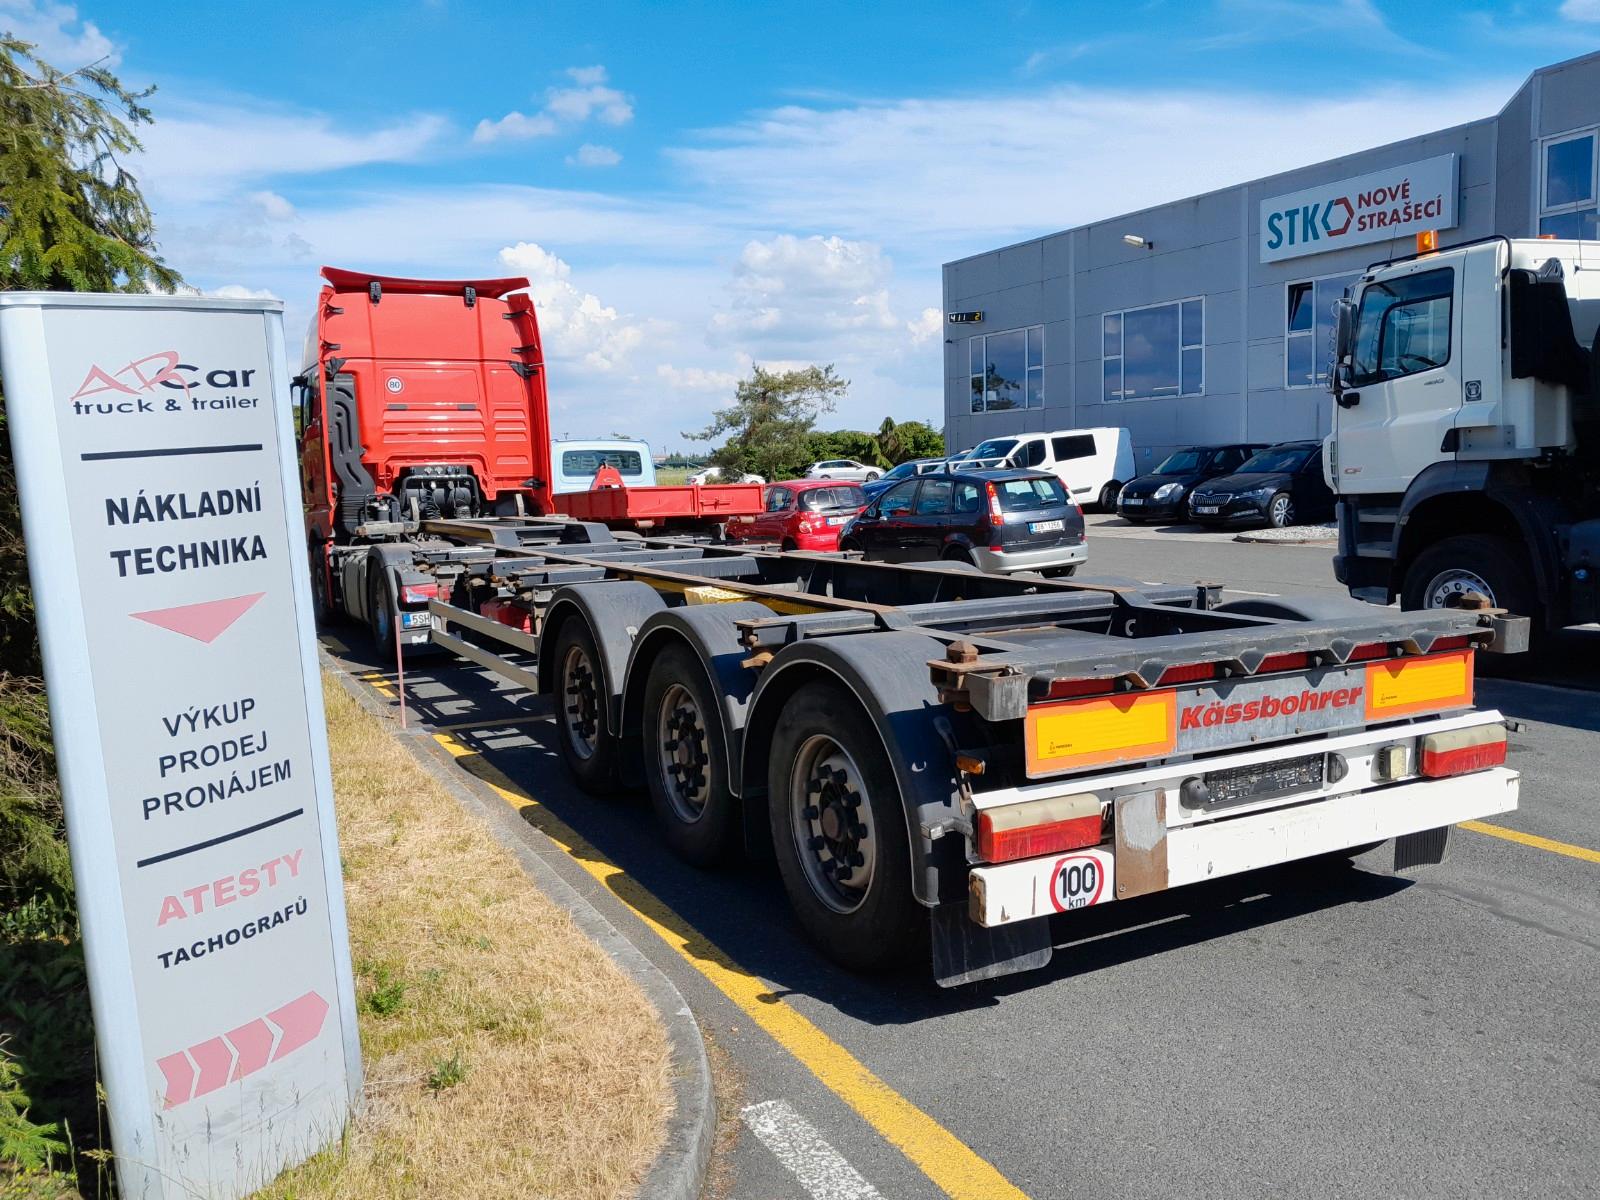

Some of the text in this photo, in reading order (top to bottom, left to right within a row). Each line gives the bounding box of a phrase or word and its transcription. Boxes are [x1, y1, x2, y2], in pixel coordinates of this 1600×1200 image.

[1357, 194, 1442, 232] STRAŠECÍ
[1358, 178, 1410, 209] NOVÉ
[1267, 203, 1320, 249] STK
[73, 396, 259, 415] truck & trailer
[105, 481, 262, 526] NÁKLADNÍ
[110, 535, 267, 577] TECHNIKA
[162, 698, 255, 737] VÝKUP
[1180, 686, 1363, 731] Kässbohrer
[159, 731, 267, 778] PRODEJ
[142, 759, 292, 820] PRONÁJEM
[157, 848, 303, 927] ATESTY
[1059, 862, 1096, 899] 100
[1068, 897, 1086, 909] km
[157, 895, 308, 969] TACHOGRAFŮ
